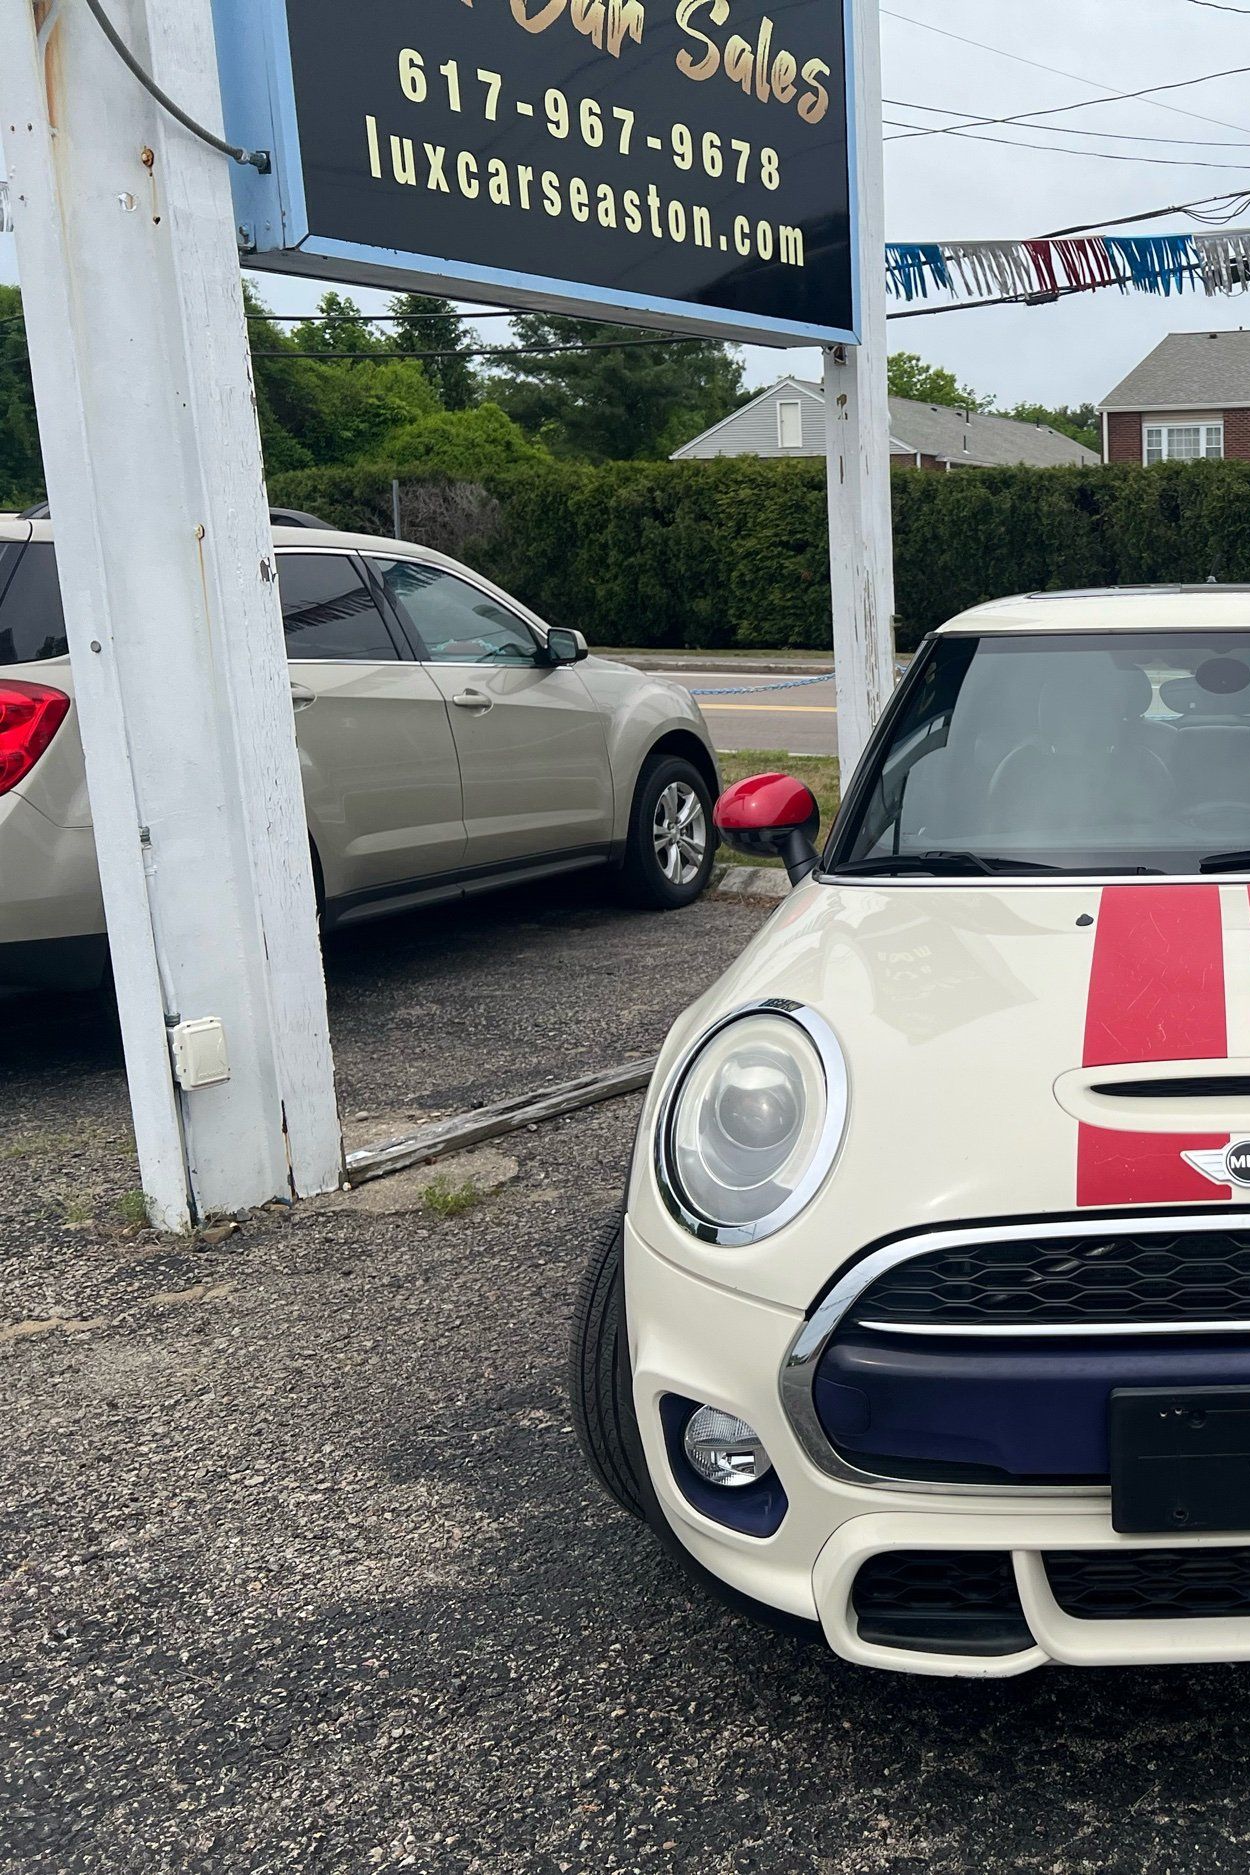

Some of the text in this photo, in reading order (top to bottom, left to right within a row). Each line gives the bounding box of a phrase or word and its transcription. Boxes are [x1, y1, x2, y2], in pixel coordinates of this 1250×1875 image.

[399, 47, 780, 191] 617-967-9678
[675, 0, 830, 124] Sales
[365, 115, 804, 267] luxcarseaston.com
